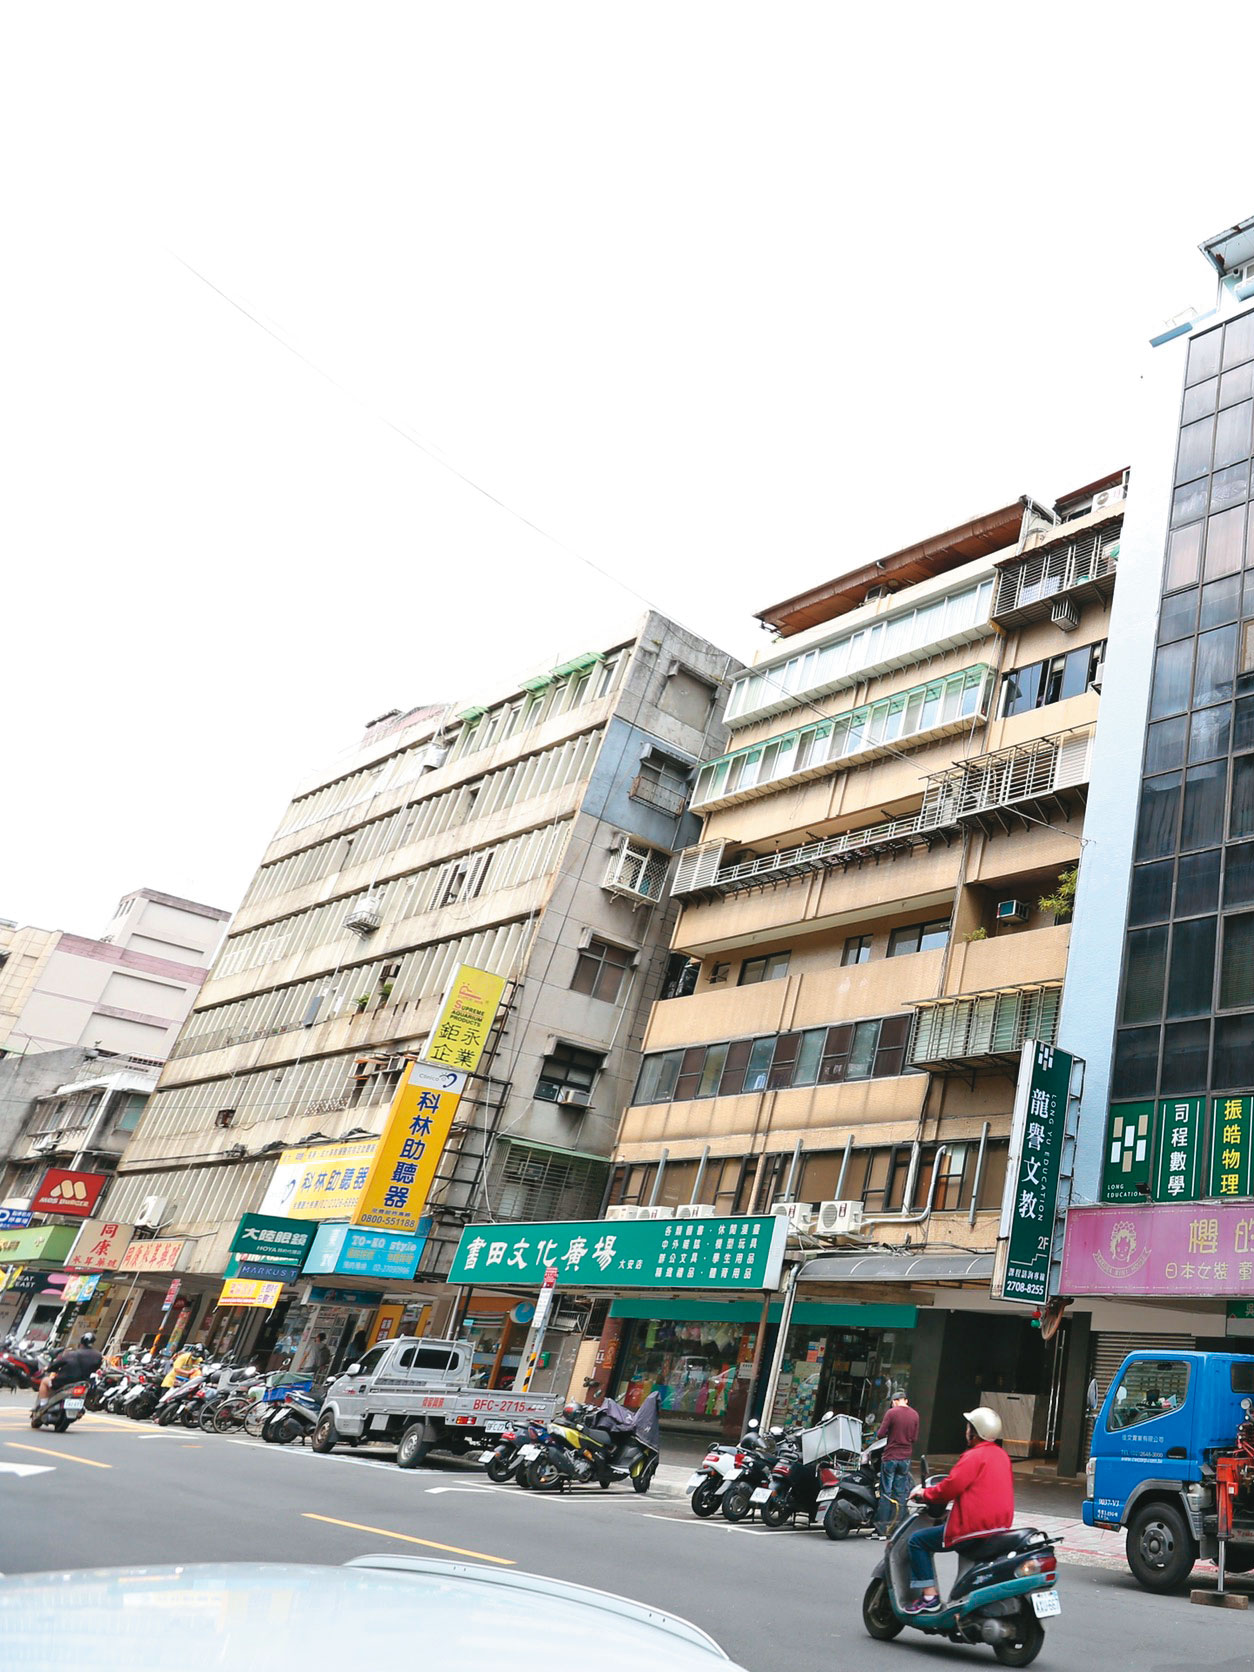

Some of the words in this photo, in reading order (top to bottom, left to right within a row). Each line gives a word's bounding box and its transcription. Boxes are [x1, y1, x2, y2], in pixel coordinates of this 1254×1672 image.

[451, 1010, 483, 1022] AQUARIUM
[454, 1000, 485, 1017] SUPREME
[449, 1014, 481, 1028] PRODUCTS
[430, 1043, 476, 1068] 企業
[1048, 1094, 1057, 1125] LONG
[1045, 1131, 1053, 1145] YU
[1220, 1099, 1243, 1195] 振皓物理
[384, 1091, 441, 1209] 科林助聽器
[1018, 1088, 1050, 1219] 龍譽文教
[1167, 1103, 1190, 1197] 司程數學
[1038, 1151, 1051, 1221] EDUCATION
[361, 1213, 416, 1228] 0800-551188
[90, 1223, 119, 1256] 同康
[241, 1227, 309, 1246] 大陸眼鏡
[1037, 1236, 1049, 1250] 2F
[256, 1245, 277, 1253] HOYA
[464, 1235, 617, 1272] 書田文化廣場
[241, 1266, 287, 1277] MARKUS
[618, 1258, 644, 1270] 大安店
[1165, 1261, 1229, 1281] 日本女裝
[1006, 1280, 1044, 1296] 2708-8255
[473, 1399, 526, 1412] BFC-2715
